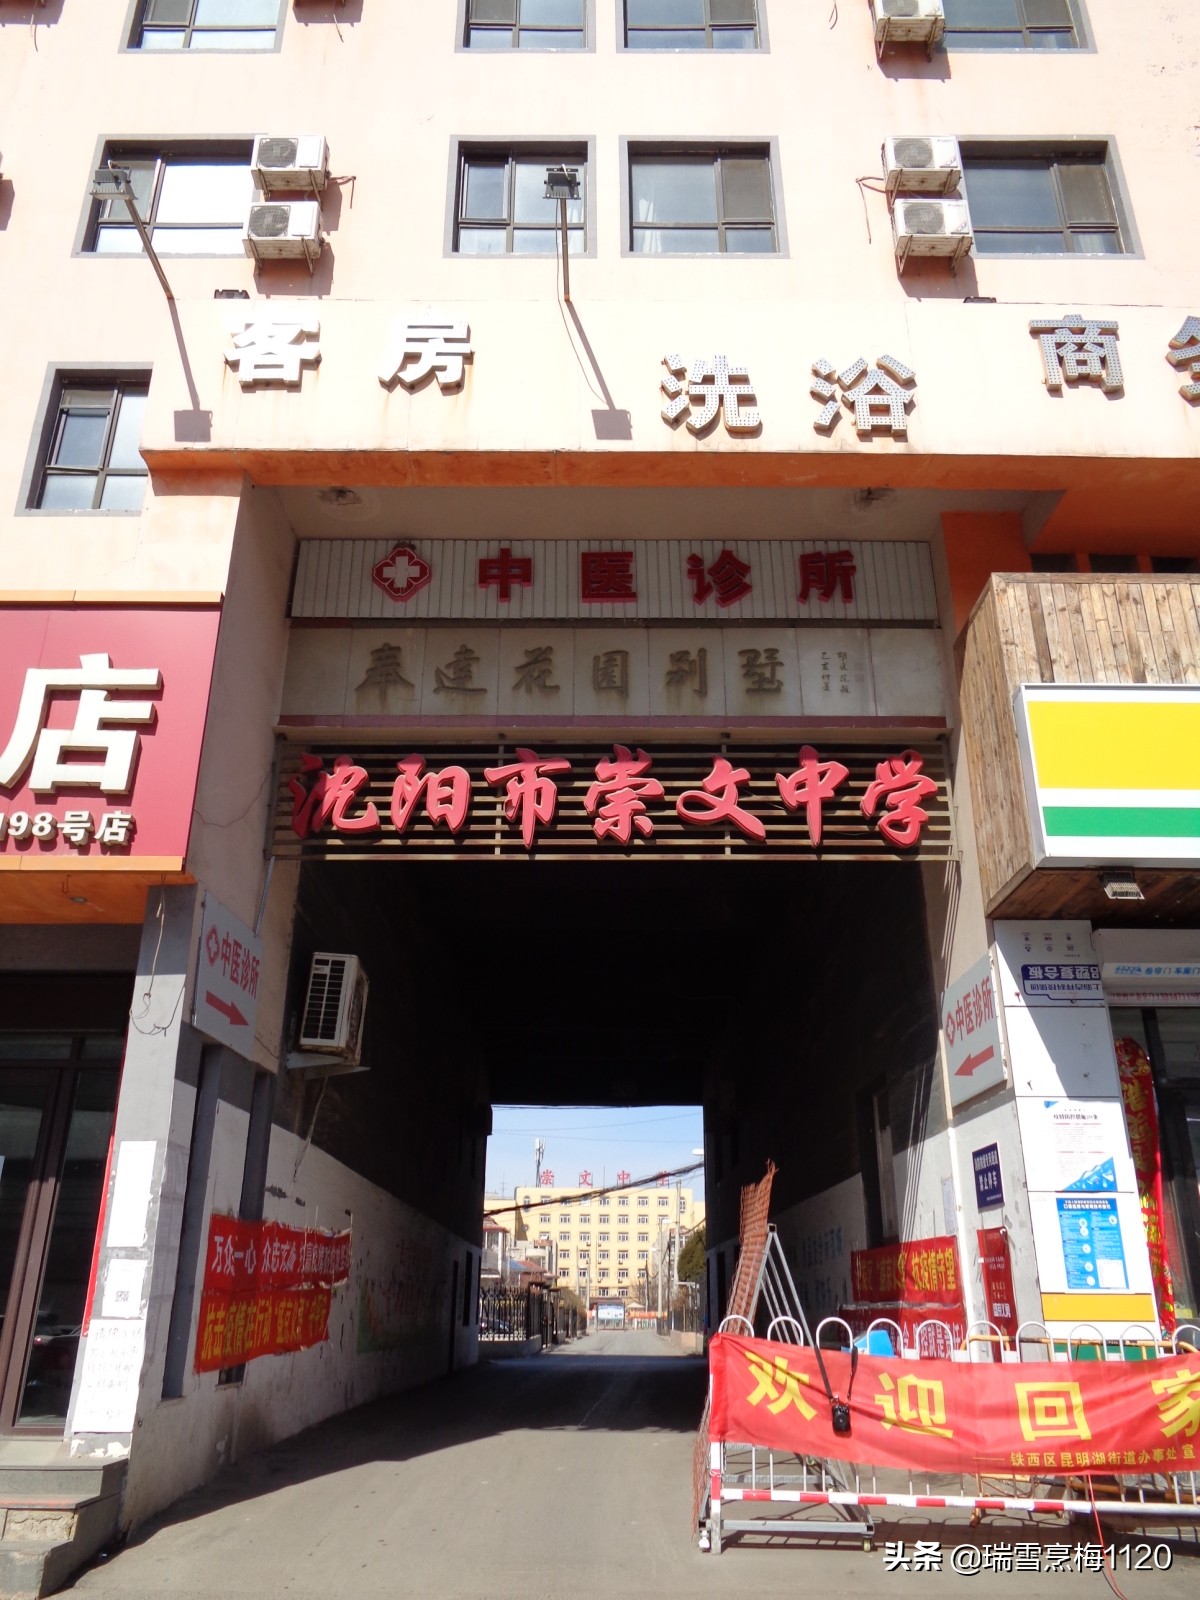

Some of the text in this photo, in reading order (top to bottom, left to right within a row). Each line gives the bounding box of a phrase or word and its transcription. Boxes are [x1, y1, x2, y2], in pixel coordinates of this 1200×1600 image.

[222, 316, 474, 393] 客房
[660, 354, 917, 436] 洗浴
[477, 547, 856, 607] 中医诊所
[0, 652, 162, 794] 店
[288, 742, 940, 850] 沈阳市崇文中学
[220, 930, 260, 1000] 中医诊所
[955, 975, 994, 1042] 中医诊所
[978, 1170, 998, 1192] 禁止停车
[211, 1234, 257, 1277] 万众一心
[745, 1350, 1200, 1442] 欢迎回家
[1181, 1443, 1196, 1459] 宣
